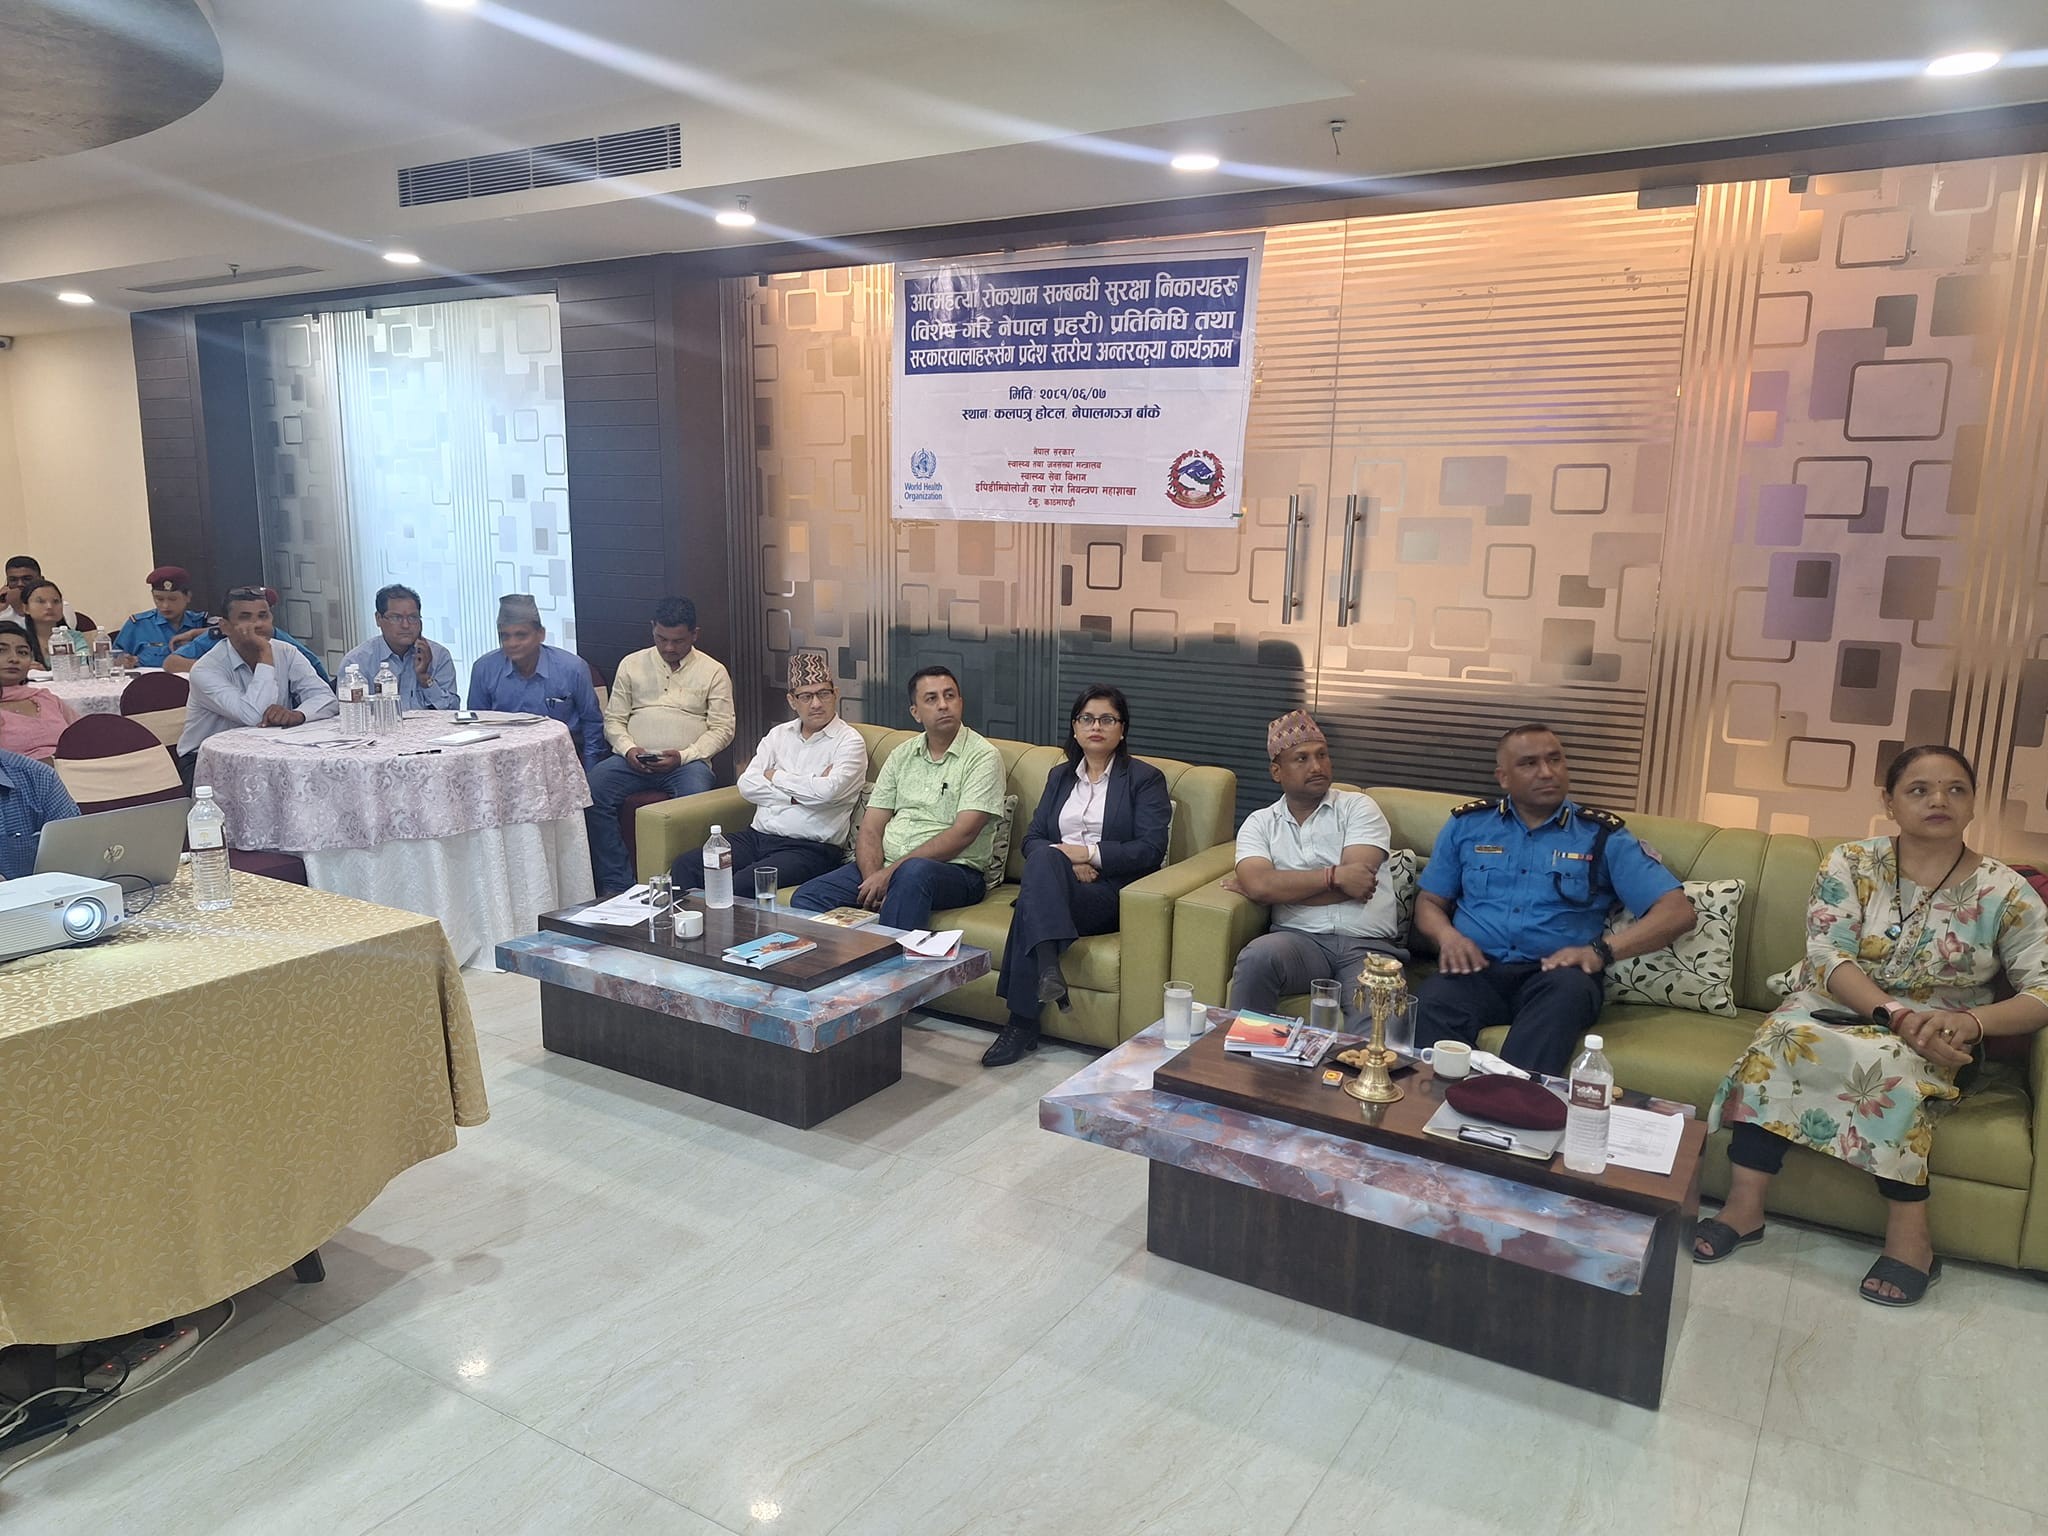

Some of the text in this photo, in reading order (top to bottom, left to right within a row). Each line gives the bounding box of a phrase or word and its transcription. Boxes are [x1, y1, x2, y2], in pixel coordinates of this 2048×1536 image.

[981, 283, 1039, 308] रोकथाम
[1042, 276, 1101, 305] सम्बन्धी
[1104, 279, 1151, 306] सुरक्षा
[962, 315, 994, 339] गरि
[998, 315, 1048, 337] नेपाल
[1053, 310, 1103, 337] प्रहरी)
[1110, 306, 1190, 336] प्रतिनिधि
[1194, 311, 1237, 331] तथा
[1018, 339, 1048, 367] प्रदेश
[1051, 337, 1092, 364] स्तरीय
[1171, 334, 1234, 361] कार्यक्रम
[1033, 447, 1076, 457] नेपाल सरकार
[1032, 460, 1044, 468] तथा
[904, 482, 943, 491] World Health
[1032, 484, 1046, 494] तथा
[1050, 482, 1064, 494] रोग
[904, 491, 943, 502] Organization
